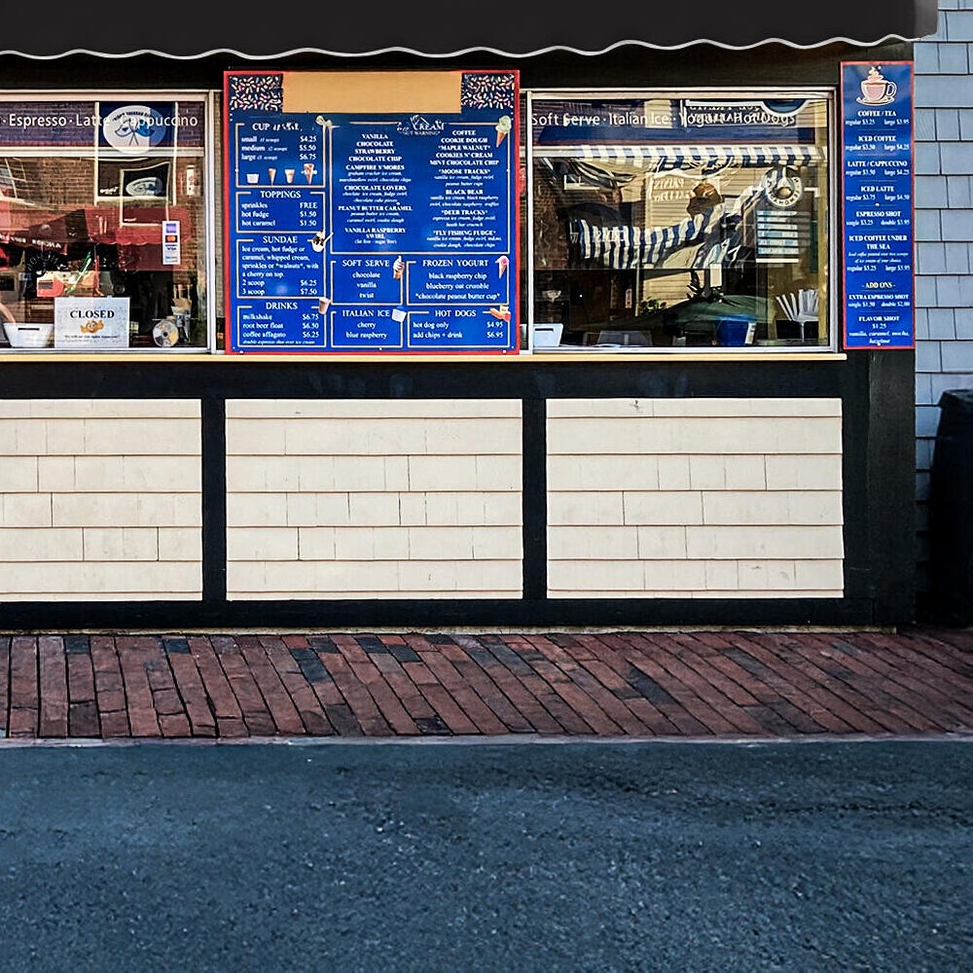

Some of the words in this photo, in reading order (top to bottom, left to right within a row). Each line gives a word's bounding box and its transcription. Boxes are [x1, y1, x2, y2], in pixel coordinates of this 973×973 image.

[9, 114, 67, 129] Espresso
[76, 114, 109, 126] Latte
[121, 114, 198, 130] Cappuccino
[532, 113, 559, 125] Soft
[563, 113, 600, 126] Serve
[609, 113, 647, 125] Italian
[652, 113, 668, 125] Ice
[252, 123, 270, 131] CUP
[300, 135, 317, 143] $4.25
[241, 154, 256, 162] large
[299, 153, 317, 161] $6.75
[253, 211, 269, 219] fudge
[263, 236, 298, 244] SUNDAE
[300, 279, 317, 287] $6.25
[266, 302, 298, 310] DRINKS
[70, 310, 115, 318] CLOSED
